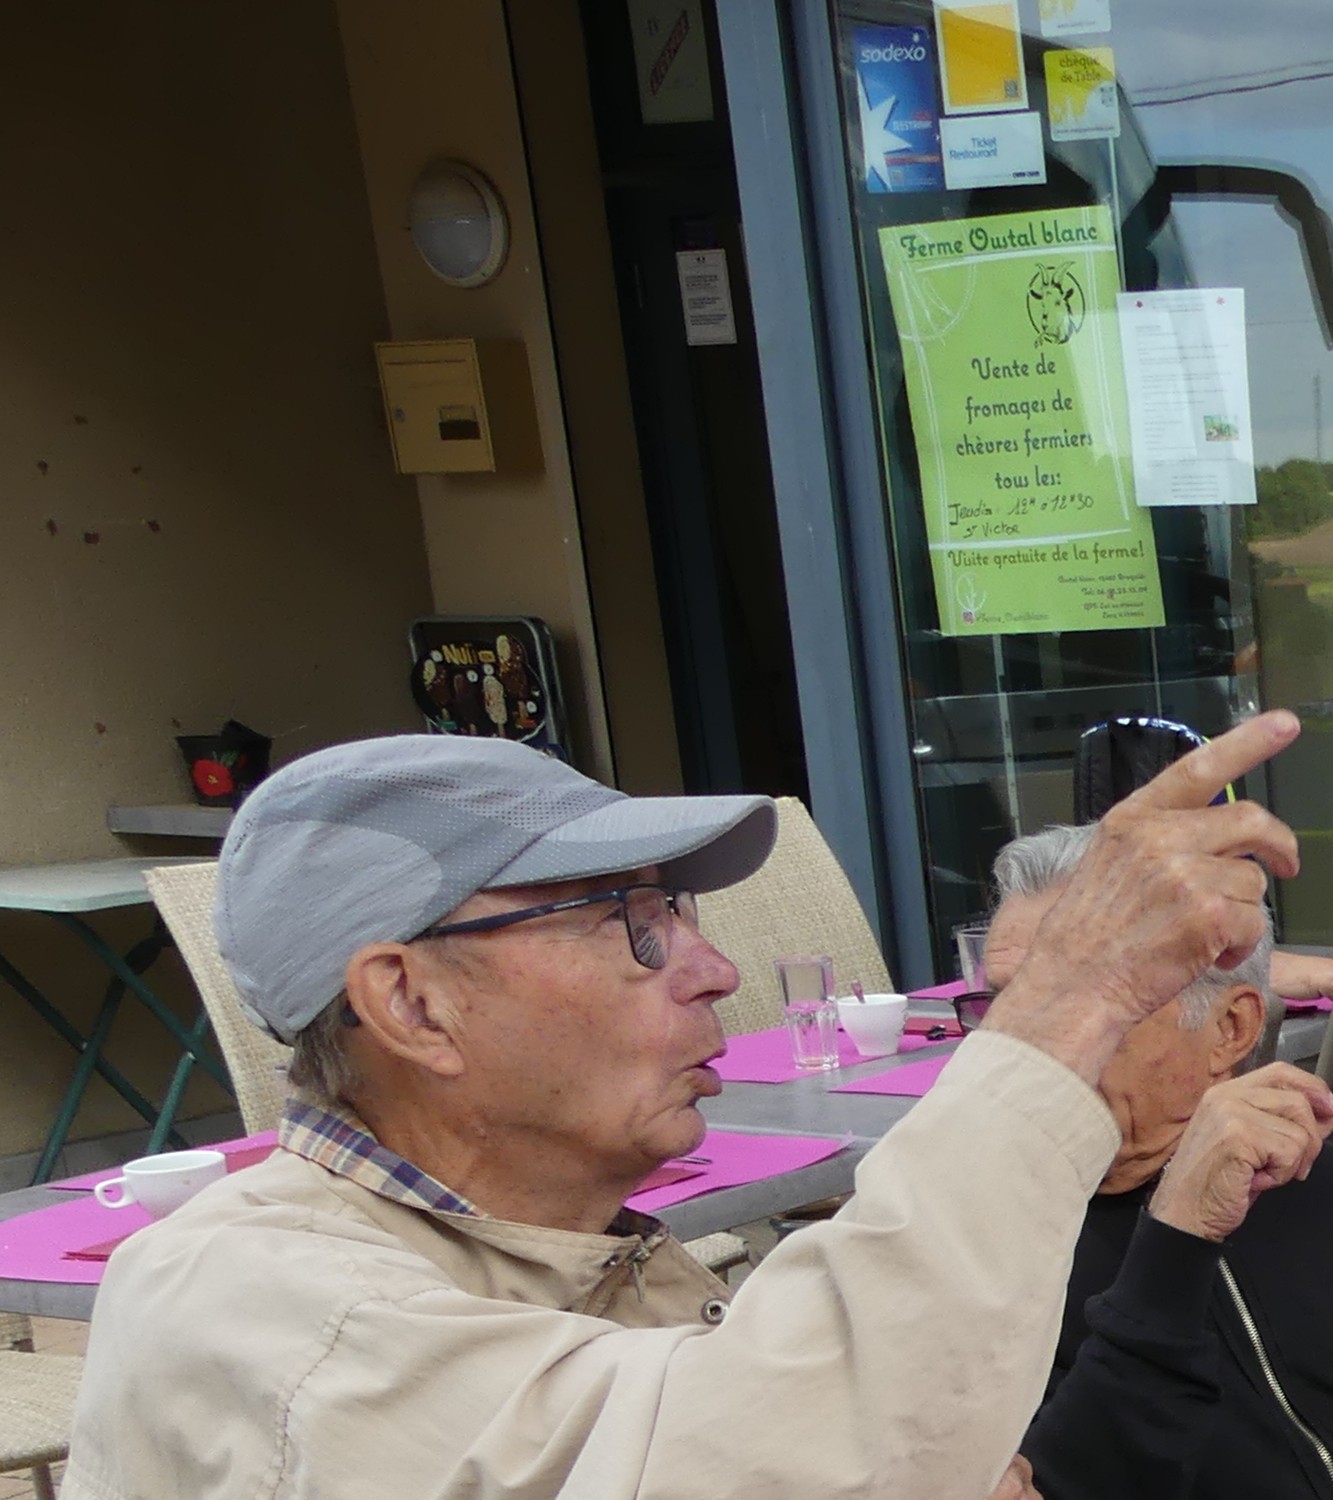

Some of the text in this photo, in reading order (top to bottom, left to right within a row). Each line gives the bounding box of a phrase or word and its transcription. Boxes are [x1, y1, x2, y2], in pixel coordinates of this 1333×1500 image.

[860, 43, 926, 63] sodexo
[971, 136, 998, 148] Ticket
[900, 220, 1098, 258] Ferme Oustal blanc
[971, 352, 1056, 380] Vente de
[965, 388, 1073, 425] fromages de
[955, 428, 1093, 457] chèvres fermiers
[994, 465, 1062, 489] tous les:
[947, 540, 1145, 569] Visite gratuite de la ferme!
